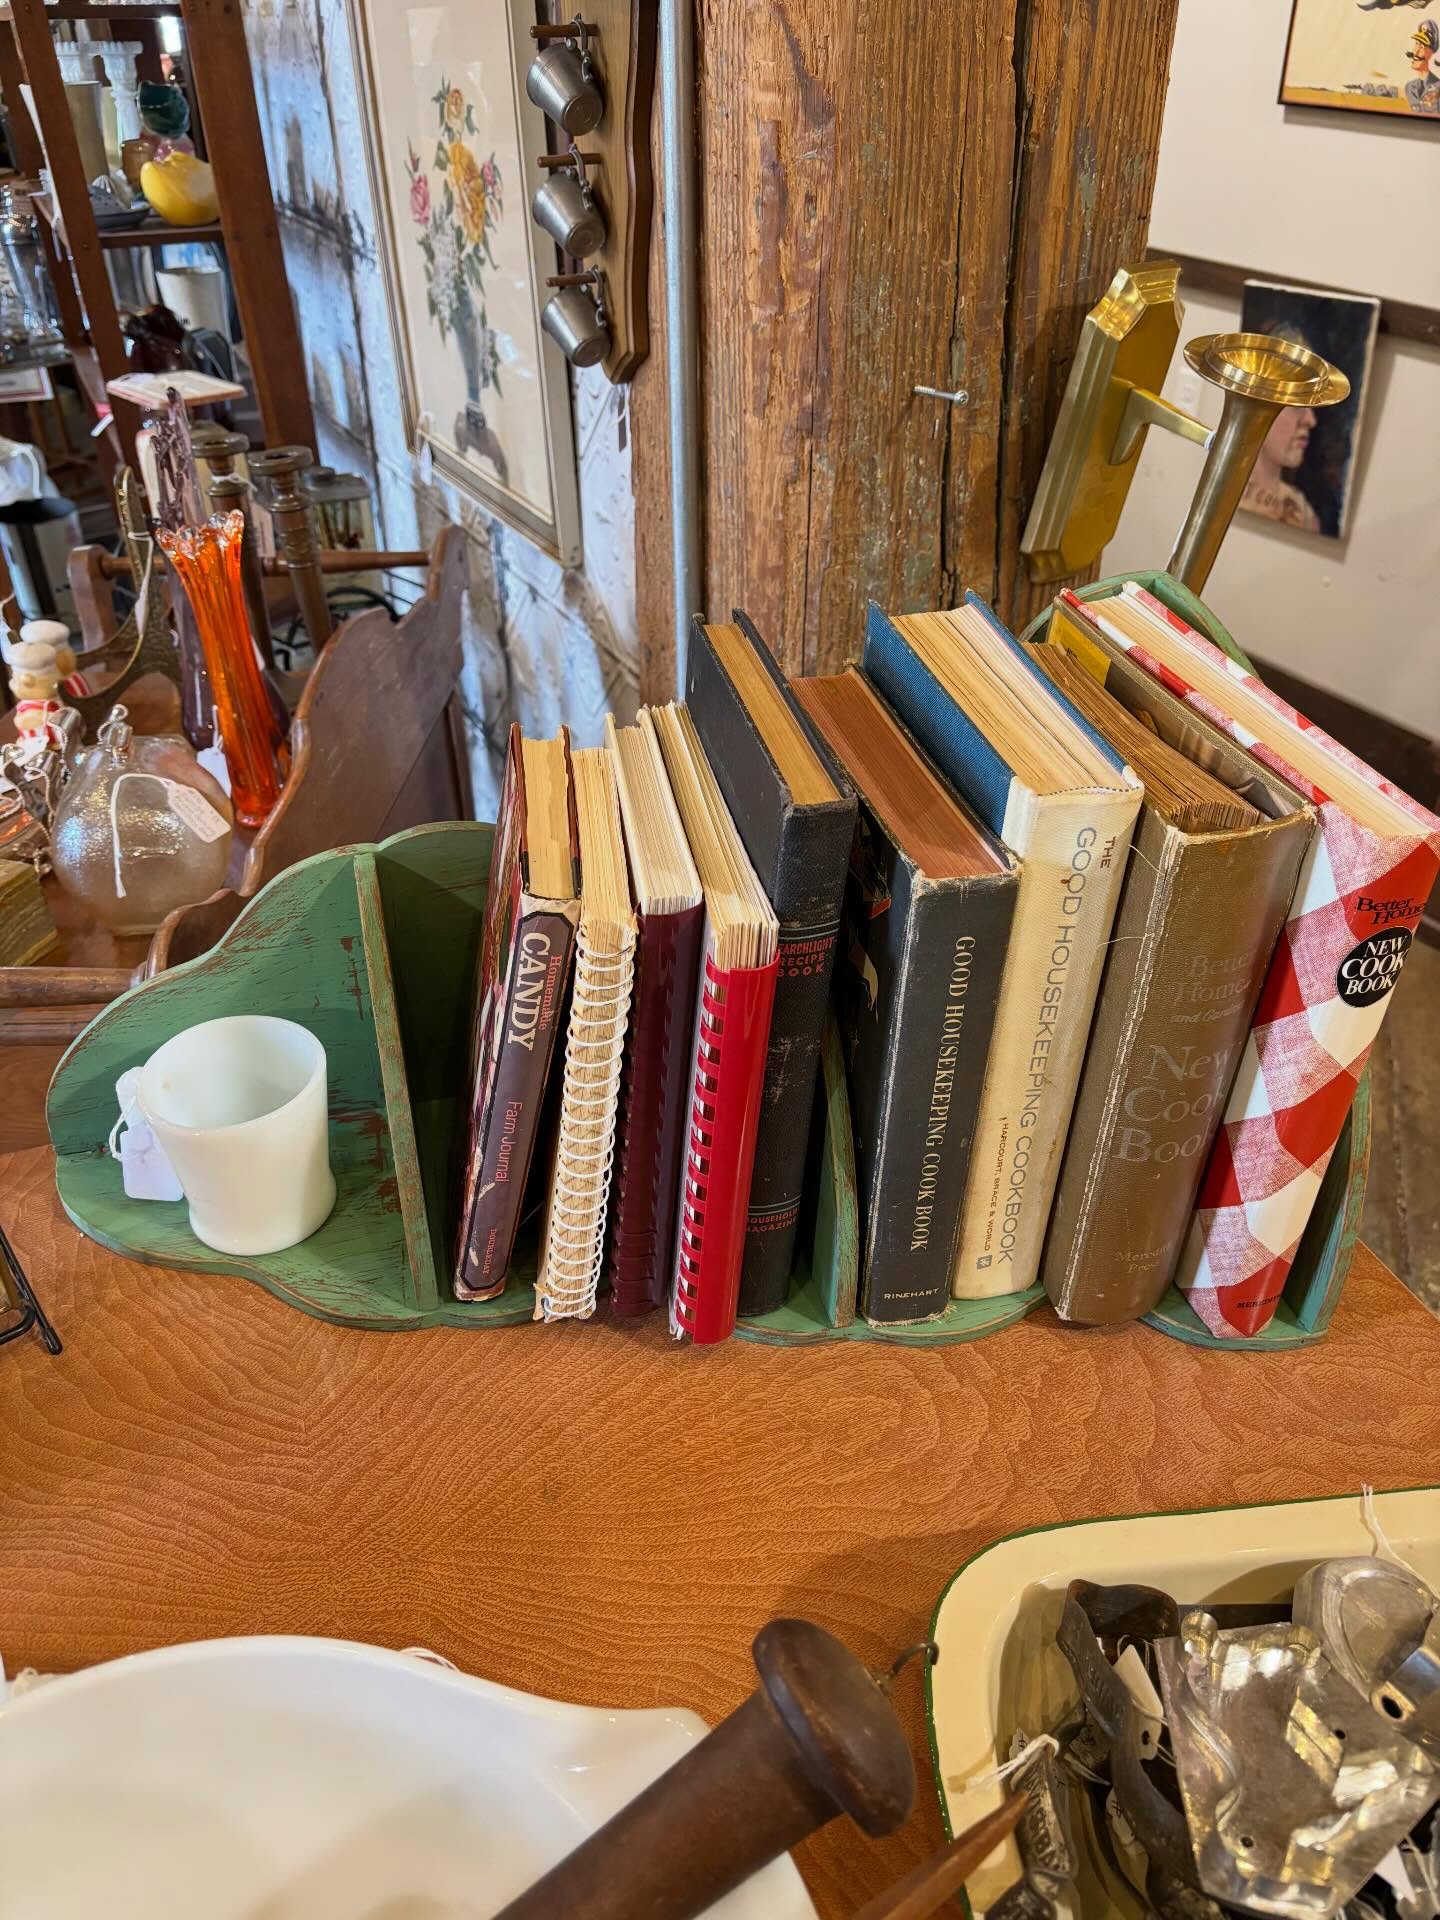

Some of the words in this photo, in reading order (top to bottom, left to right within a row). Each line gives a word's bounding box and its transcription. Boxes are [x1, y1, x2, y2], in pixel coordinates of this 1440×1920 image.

[1062, 827, 1097, 915] GOOD
[1100, 836, 1116, 869] THE
[1356, 896, 1414, 912] Better
[949, 936, 976, 997] GOOD
[1341, 948, 1408, 979] COOK
[1364, 936, 1407, 958] NEW
[508, 932, 551, 1051] CANDY
[1344, 972, 1395, 995] BOOK
[1020, 925, 1076, 1129] HOUSEKEEPING
[925, 1003, 965, 1147] HOUSEKEEPING
[505, 1100, 523, 1134] Farm
[494, 1136, 517, 1182] Journal
[917, 1153, 941, 1201] COOK
[990, 1178, 1001, 1208] BRACE
[998, 1135, 1033, 1264] COOKBOOK
[910, 1205, 933, 1252] BOOK
[984, 1220, 994, 1251] WORLD
[884, 1288, 939, 1299] RINEHART
